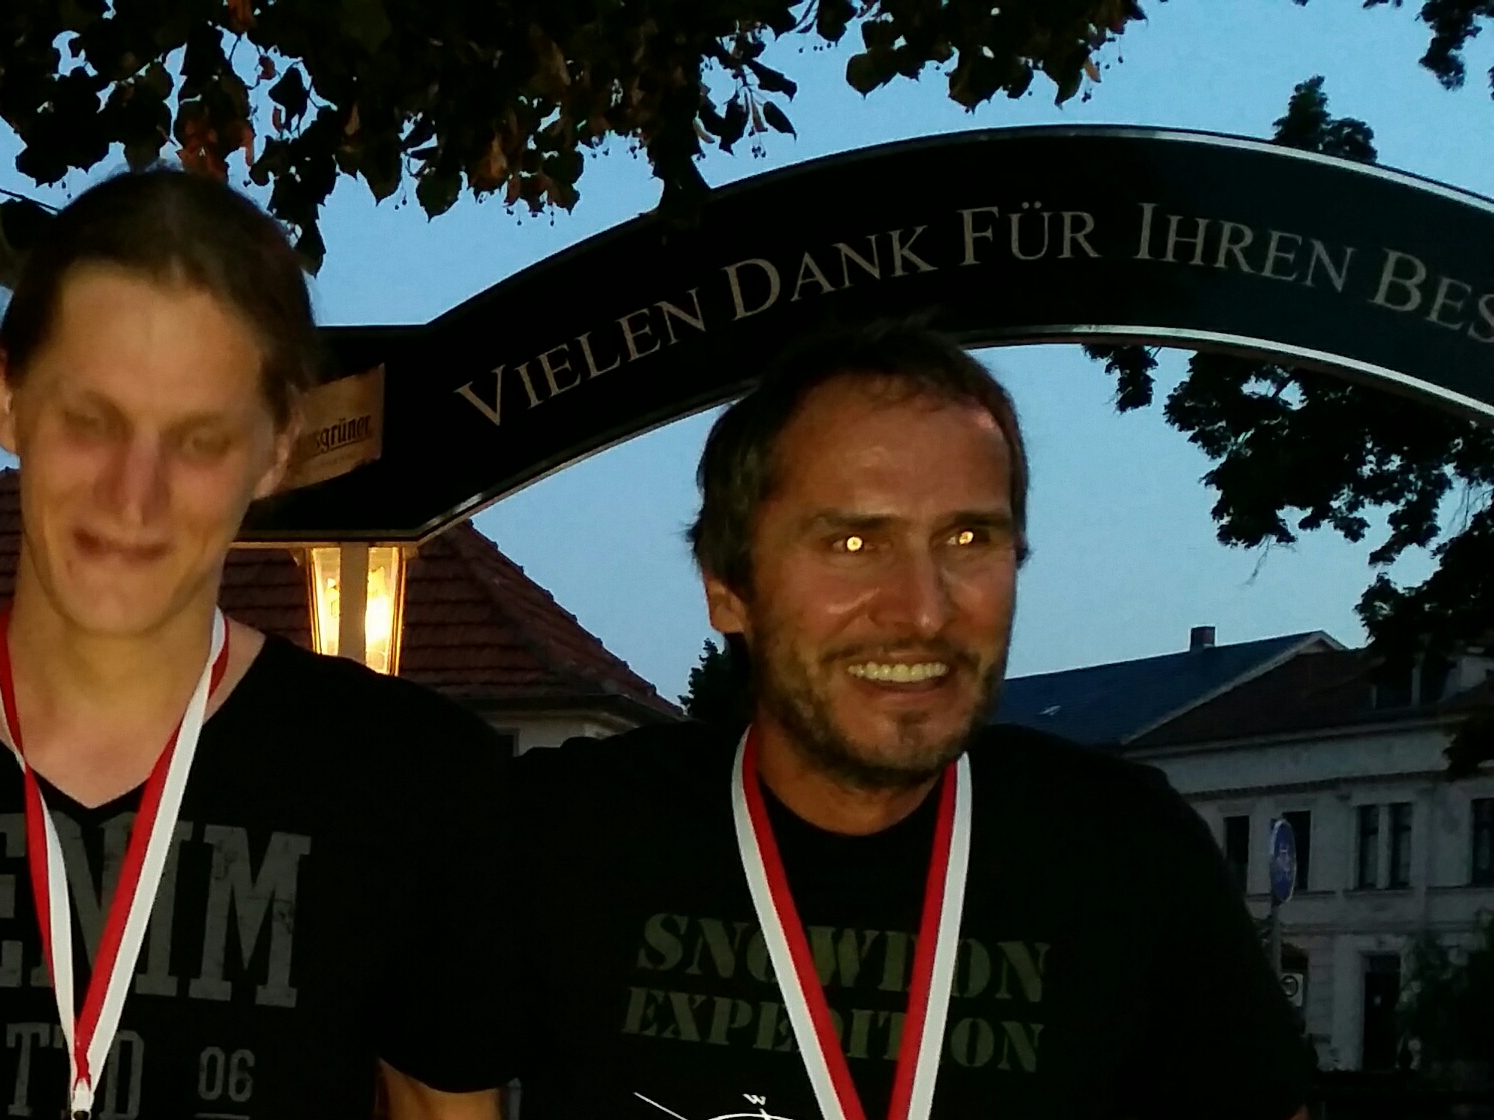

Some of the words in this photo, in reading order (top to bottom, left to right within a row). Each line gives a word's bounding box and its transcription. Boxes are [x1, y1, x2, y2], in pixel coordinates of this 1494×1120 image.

[453, 287, 708, 427] VIELEN
[719, 225, 941, 322] DANK
[956, 201, 1104, 267] FÜR
[1133, 201, 1358, 294] IHREN
[197, 1045, 256, 1102] 06
[621, 985, 1046, 1075] EXPEITON
